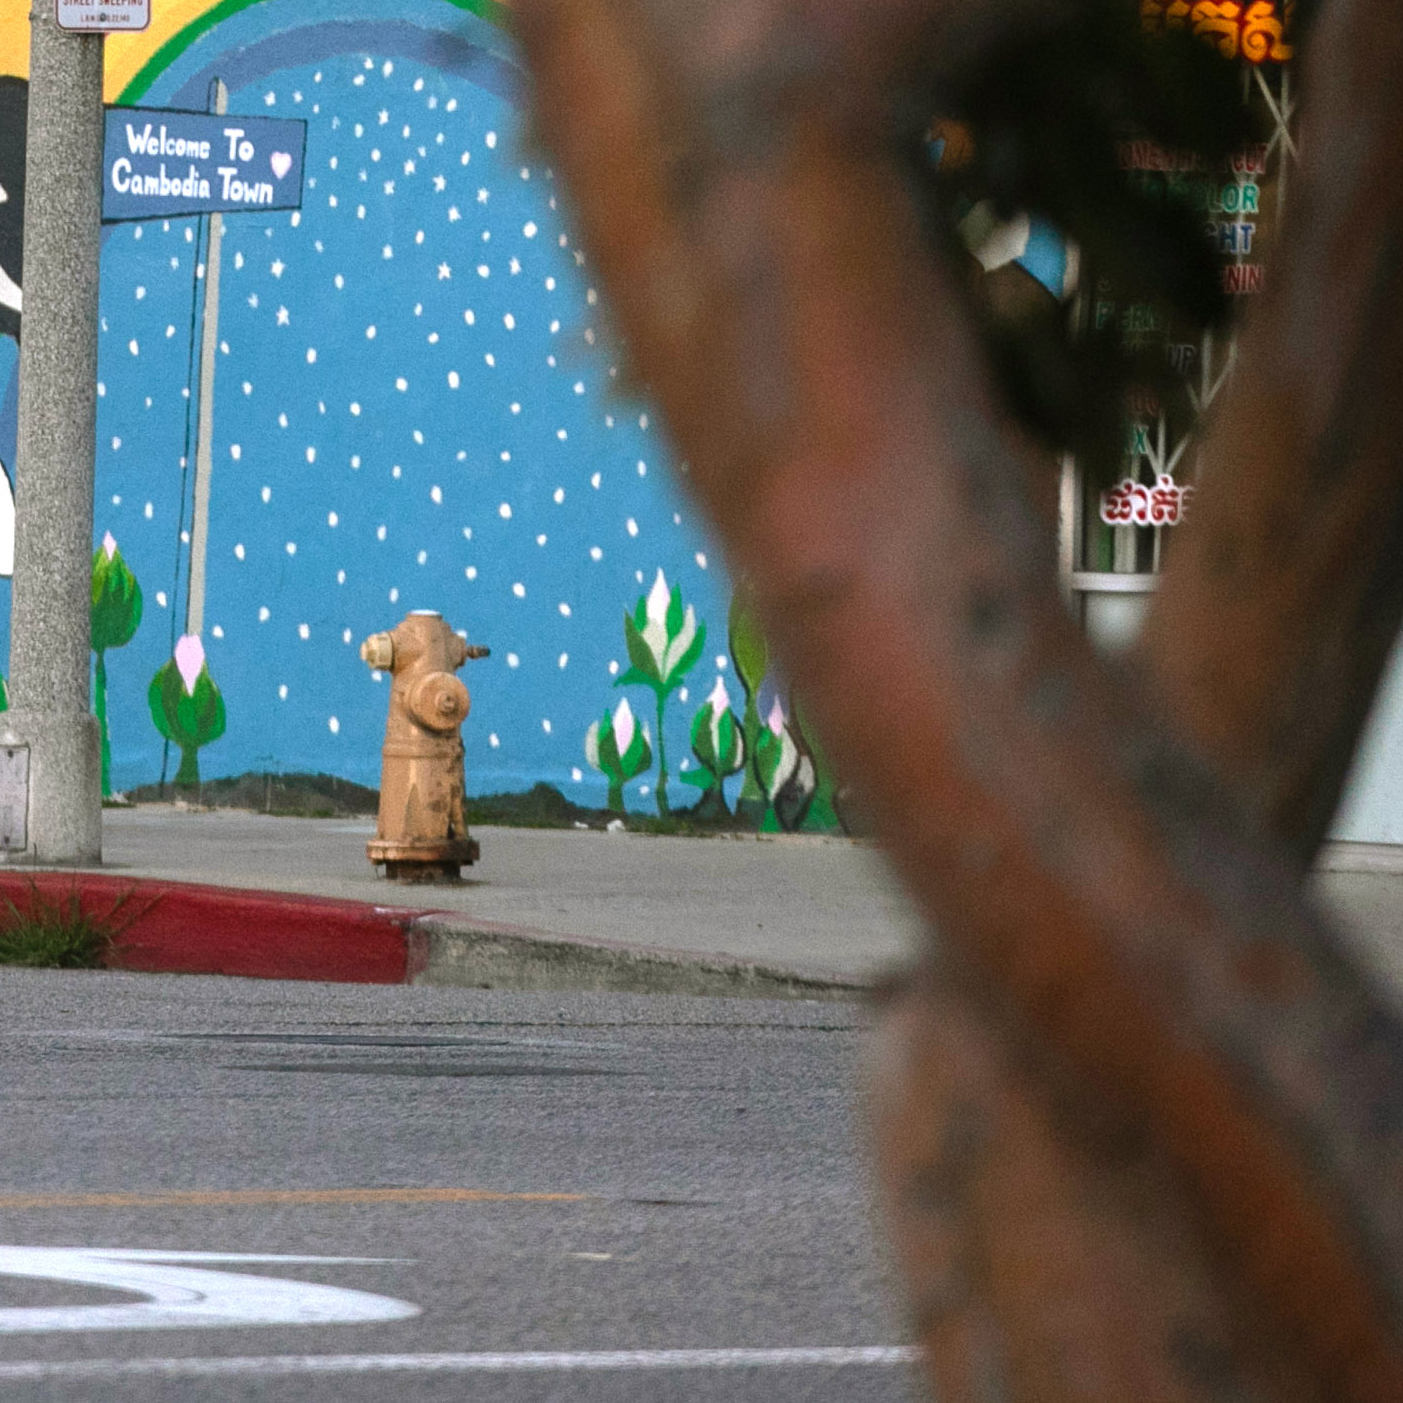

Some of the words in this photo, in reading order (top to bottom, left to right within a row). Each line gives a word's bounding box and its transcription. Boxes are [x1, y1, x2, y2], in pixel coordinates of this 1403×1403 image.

[125, 124, 211, 160] Welcome
[223, 128, 255, 162] To
[111, 157, 211, 199] Cambodia
[217, 167, 274, 204] Town
